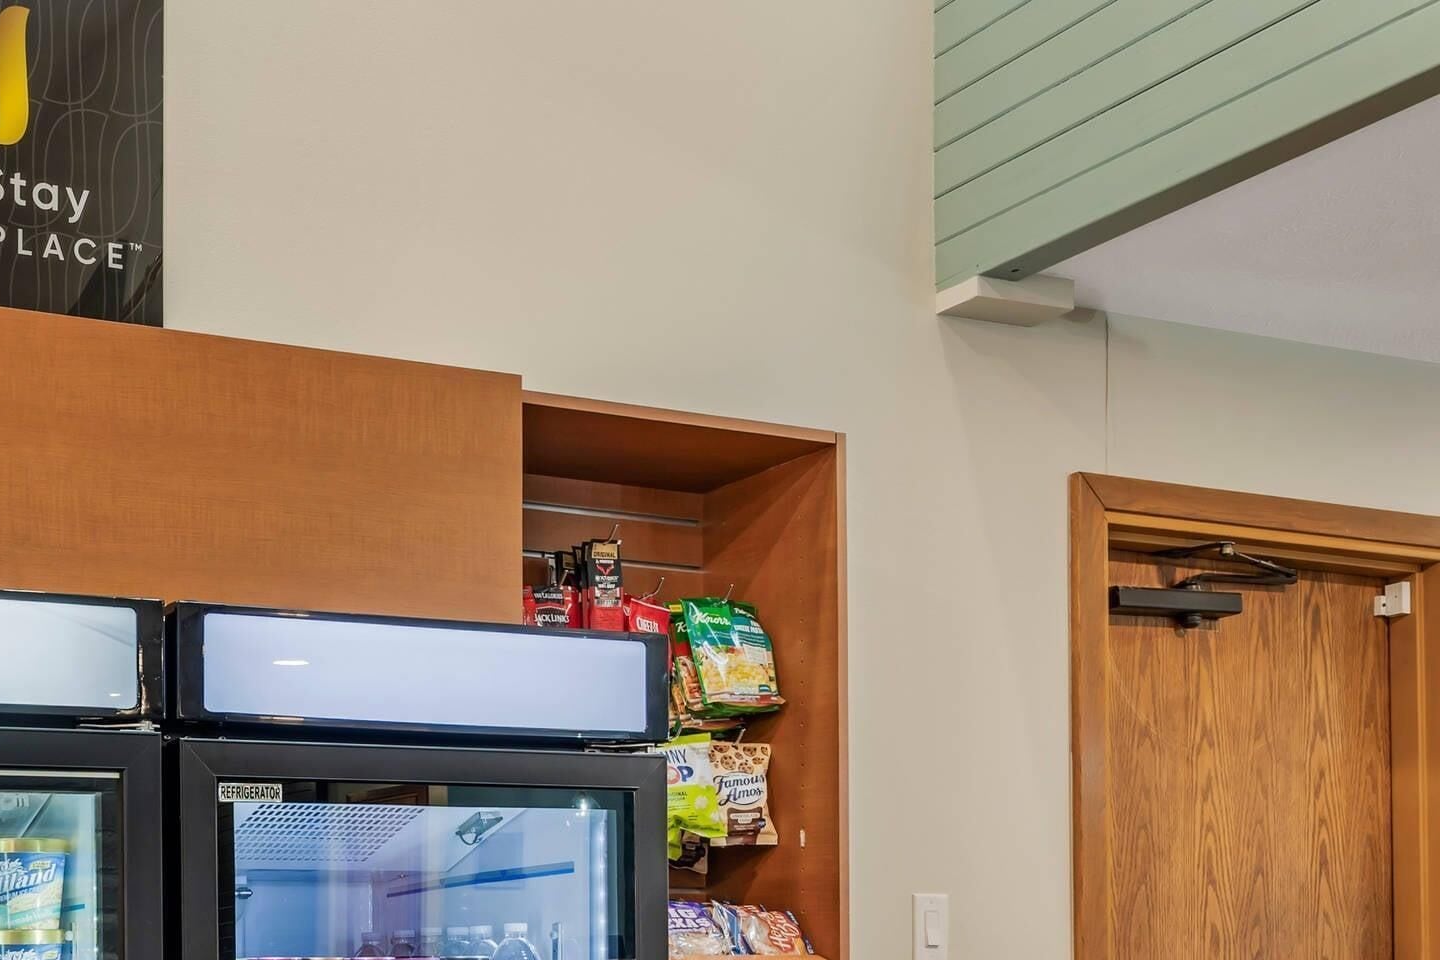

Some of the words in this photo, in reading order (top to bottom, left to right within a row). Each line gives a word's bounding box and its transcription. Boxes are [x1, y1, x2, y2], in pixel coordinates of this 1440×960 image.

[692, 612, 732, 626] Knorr
[220, 785, 281, 800] REFRIGERATOR
[712, 774, 766, 796] Famous
[718, 787, 764, 807] Amos
